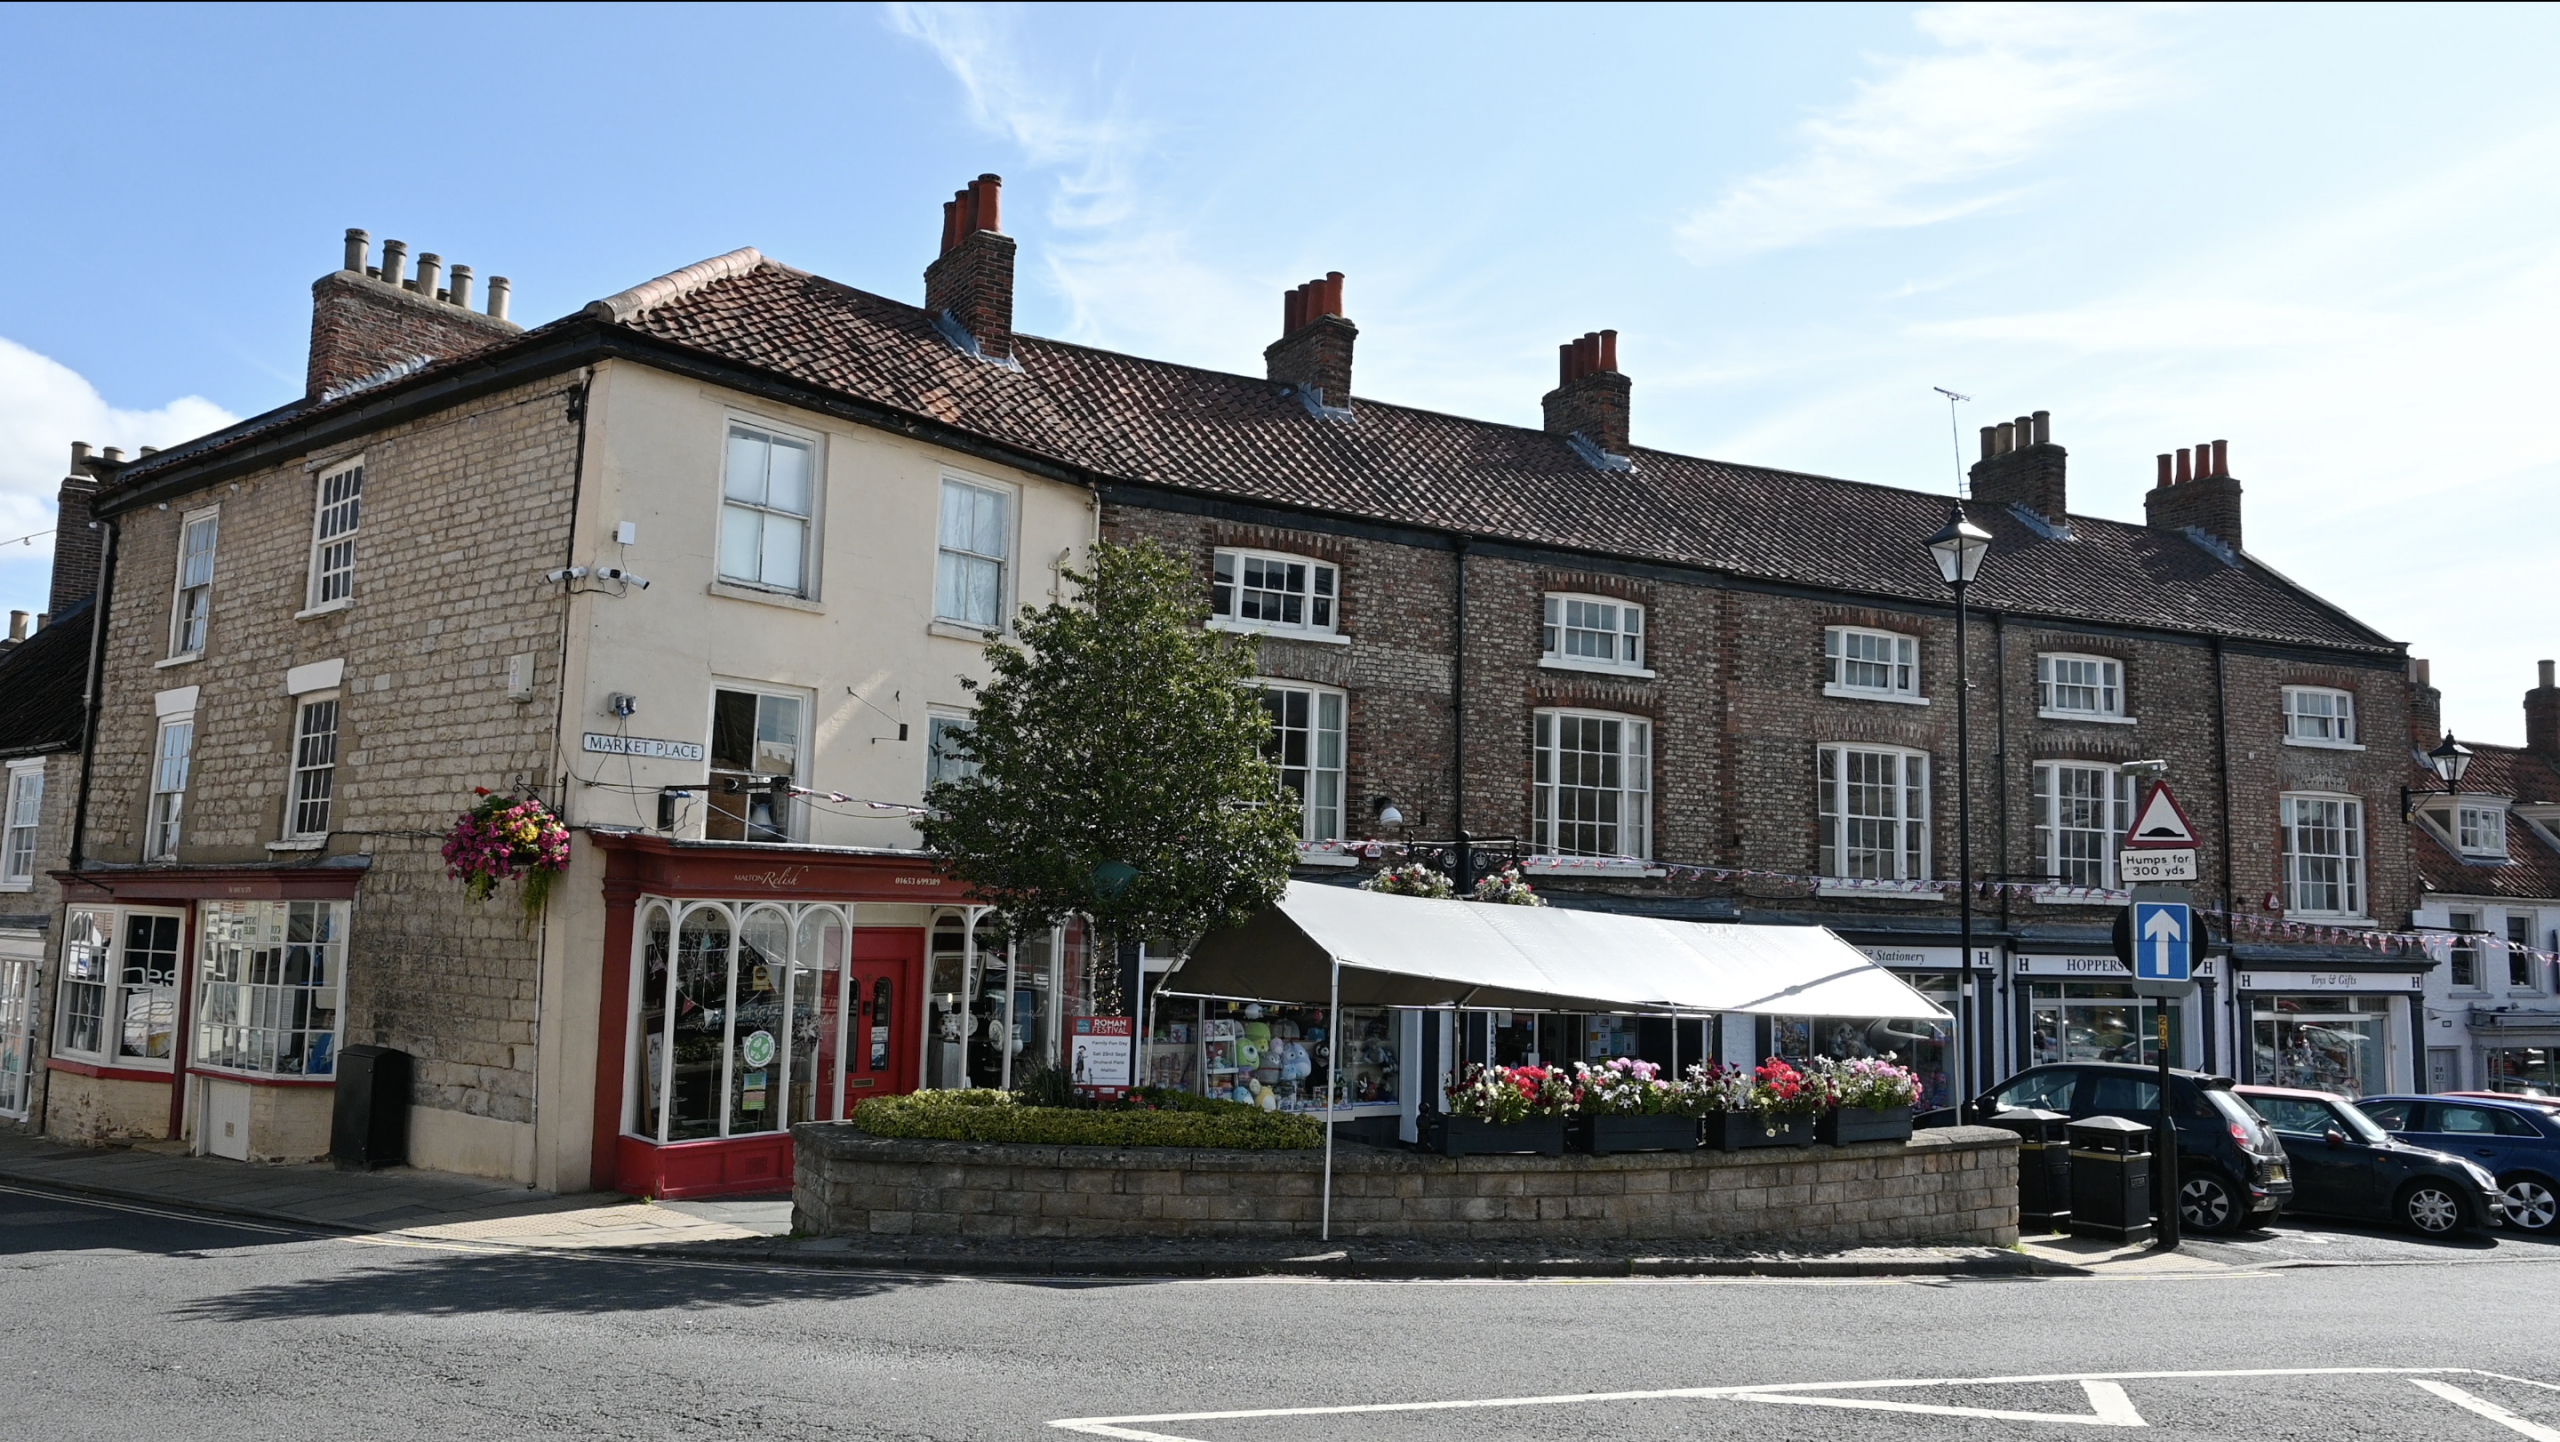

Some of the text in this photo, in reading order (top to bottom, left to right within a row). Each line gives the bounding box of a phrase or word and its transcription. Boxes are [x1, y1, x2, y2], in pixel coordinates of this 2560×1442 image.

[589, 736, 698, 758] MARKET PLACE
[2126, 854, 2189, 865] Humps for
[734, 865, 809, 889] MALTON Relish
[2133, 866, 2159, 876] 300
[2165, 866, 2185, 876] yds
[895, 876, 941, 886] 01653 699389
[1876, 949, 1925, 965] Stationery
[1978, 951, 1990, 965] H
[2018, 957, 2030, 972] H
[2066, 958, 2124, 972] HOPPERS
[2203, 961, 2213, 974] H
[2241, 974, 2251, 987] H
[2310, 974, 2357, 988] Toys & Gifts
[2411, 976, 2420, 989] H
[1094, 1019, 1127, 1027] ROMAN
[1092, 1026, 1128, 1034] FESTIVAL
